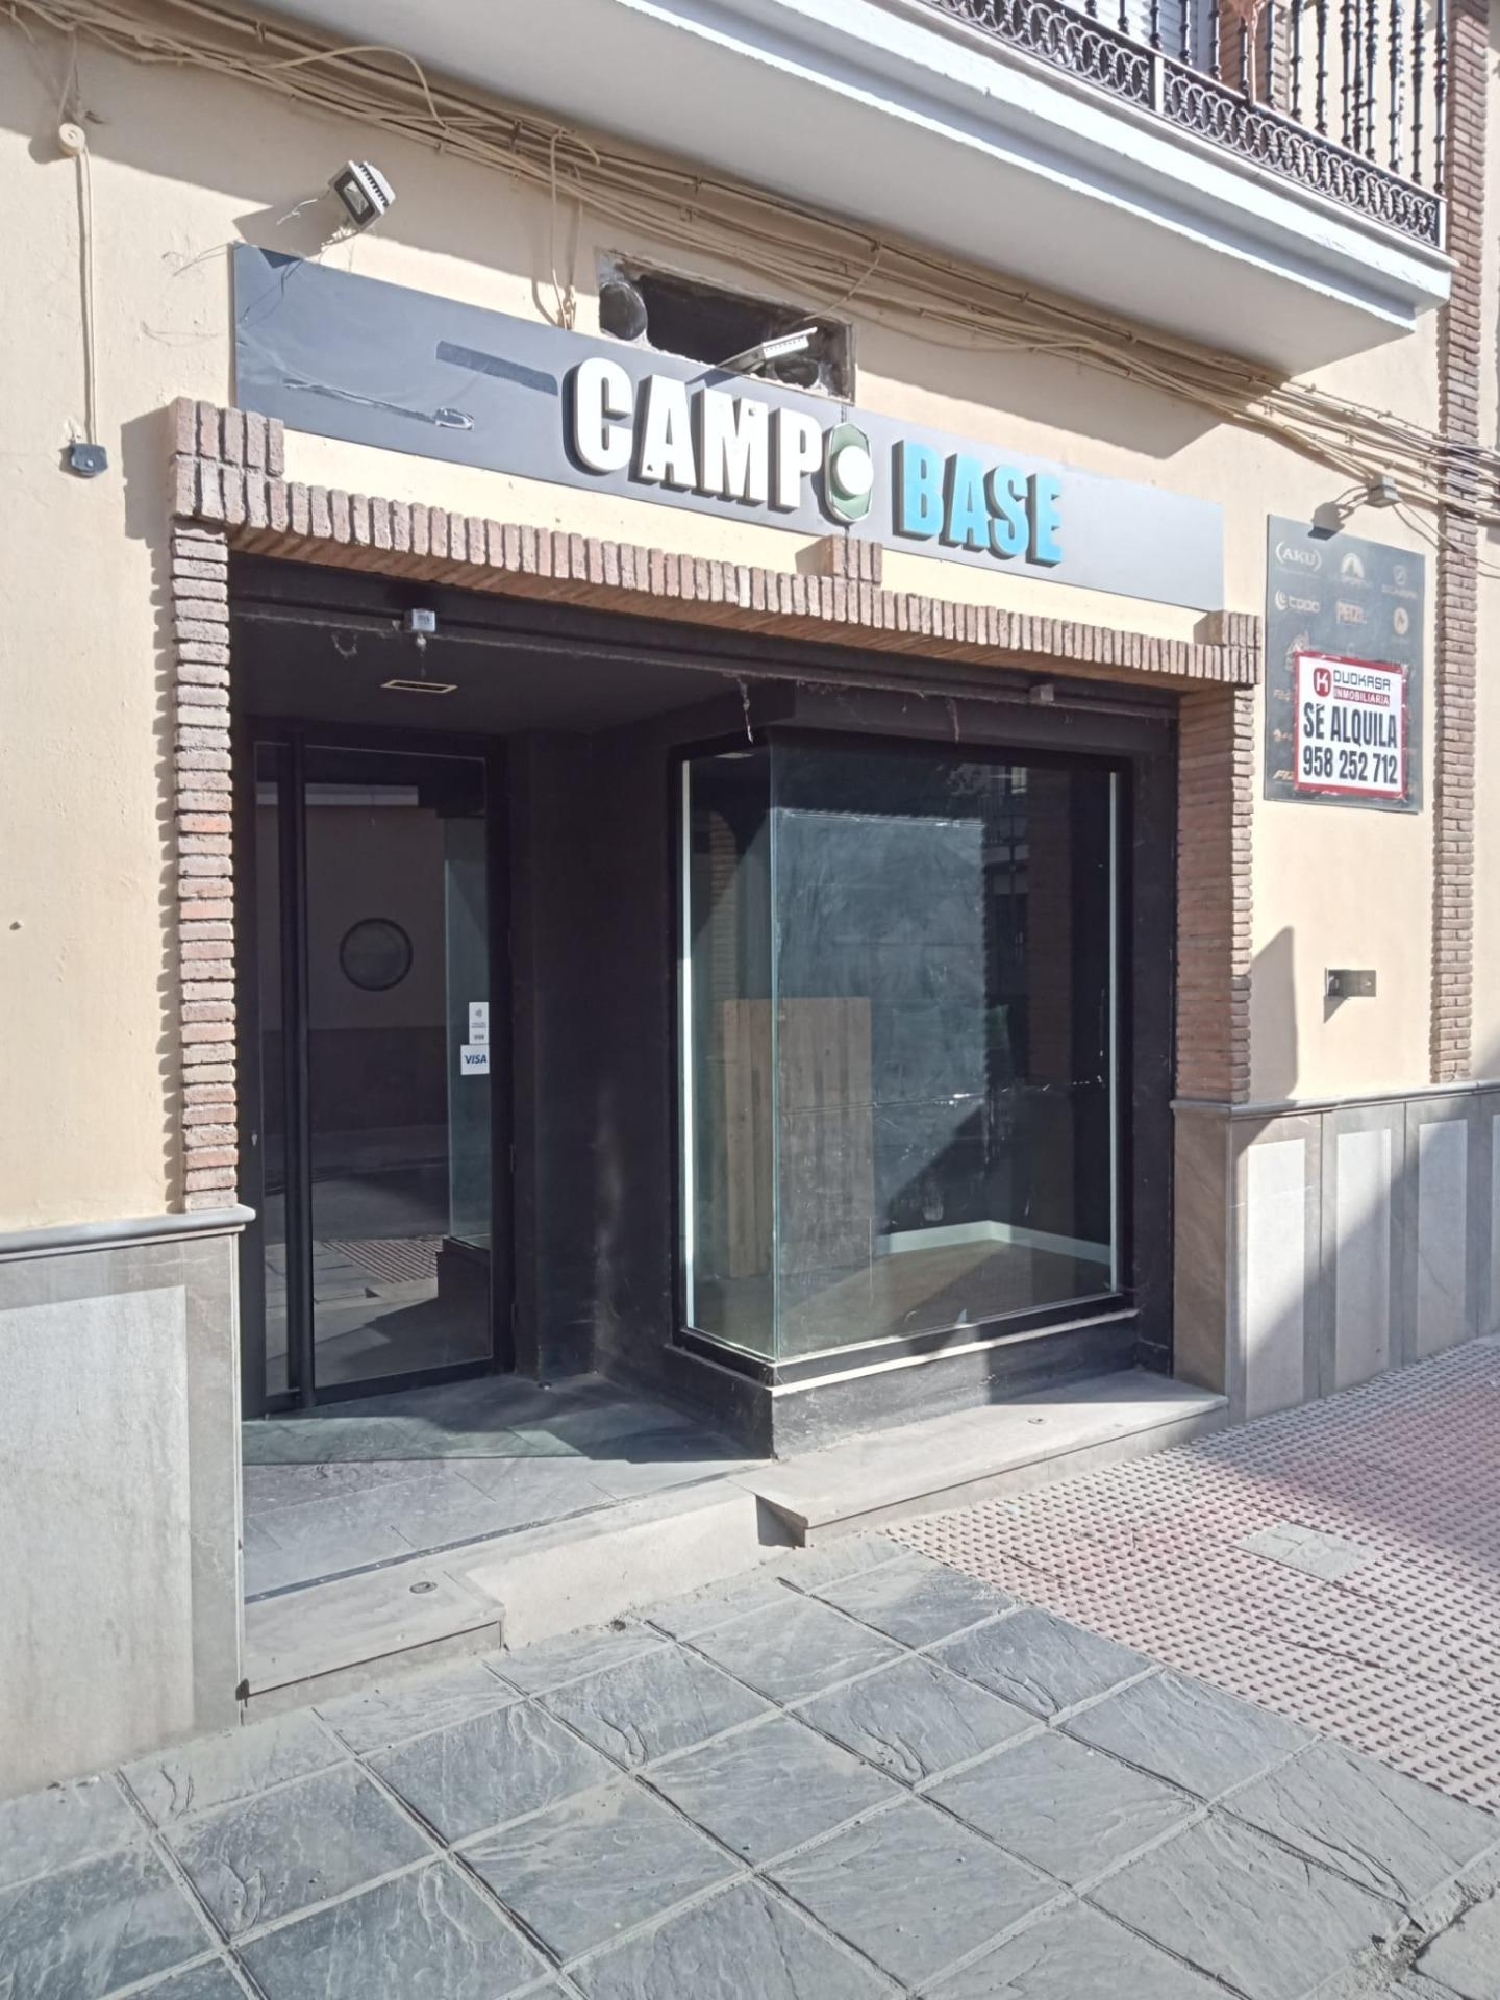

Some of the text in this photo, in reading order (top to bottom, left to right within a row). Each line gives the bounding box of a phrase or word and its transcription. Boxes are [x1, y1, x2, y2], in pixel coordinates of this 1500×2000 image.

[895, 440, 1063, 565] BASE
[1333, 670, 1391, 691] DUOKASA
[1334, 686, 1390, 706] INMOBILIARIA
[1303, 702, 1398, 748] SE ALQUILA
[1303, 745, 1398, 784] 958 252 712
[464, 1053, 487, 1065] VISA
